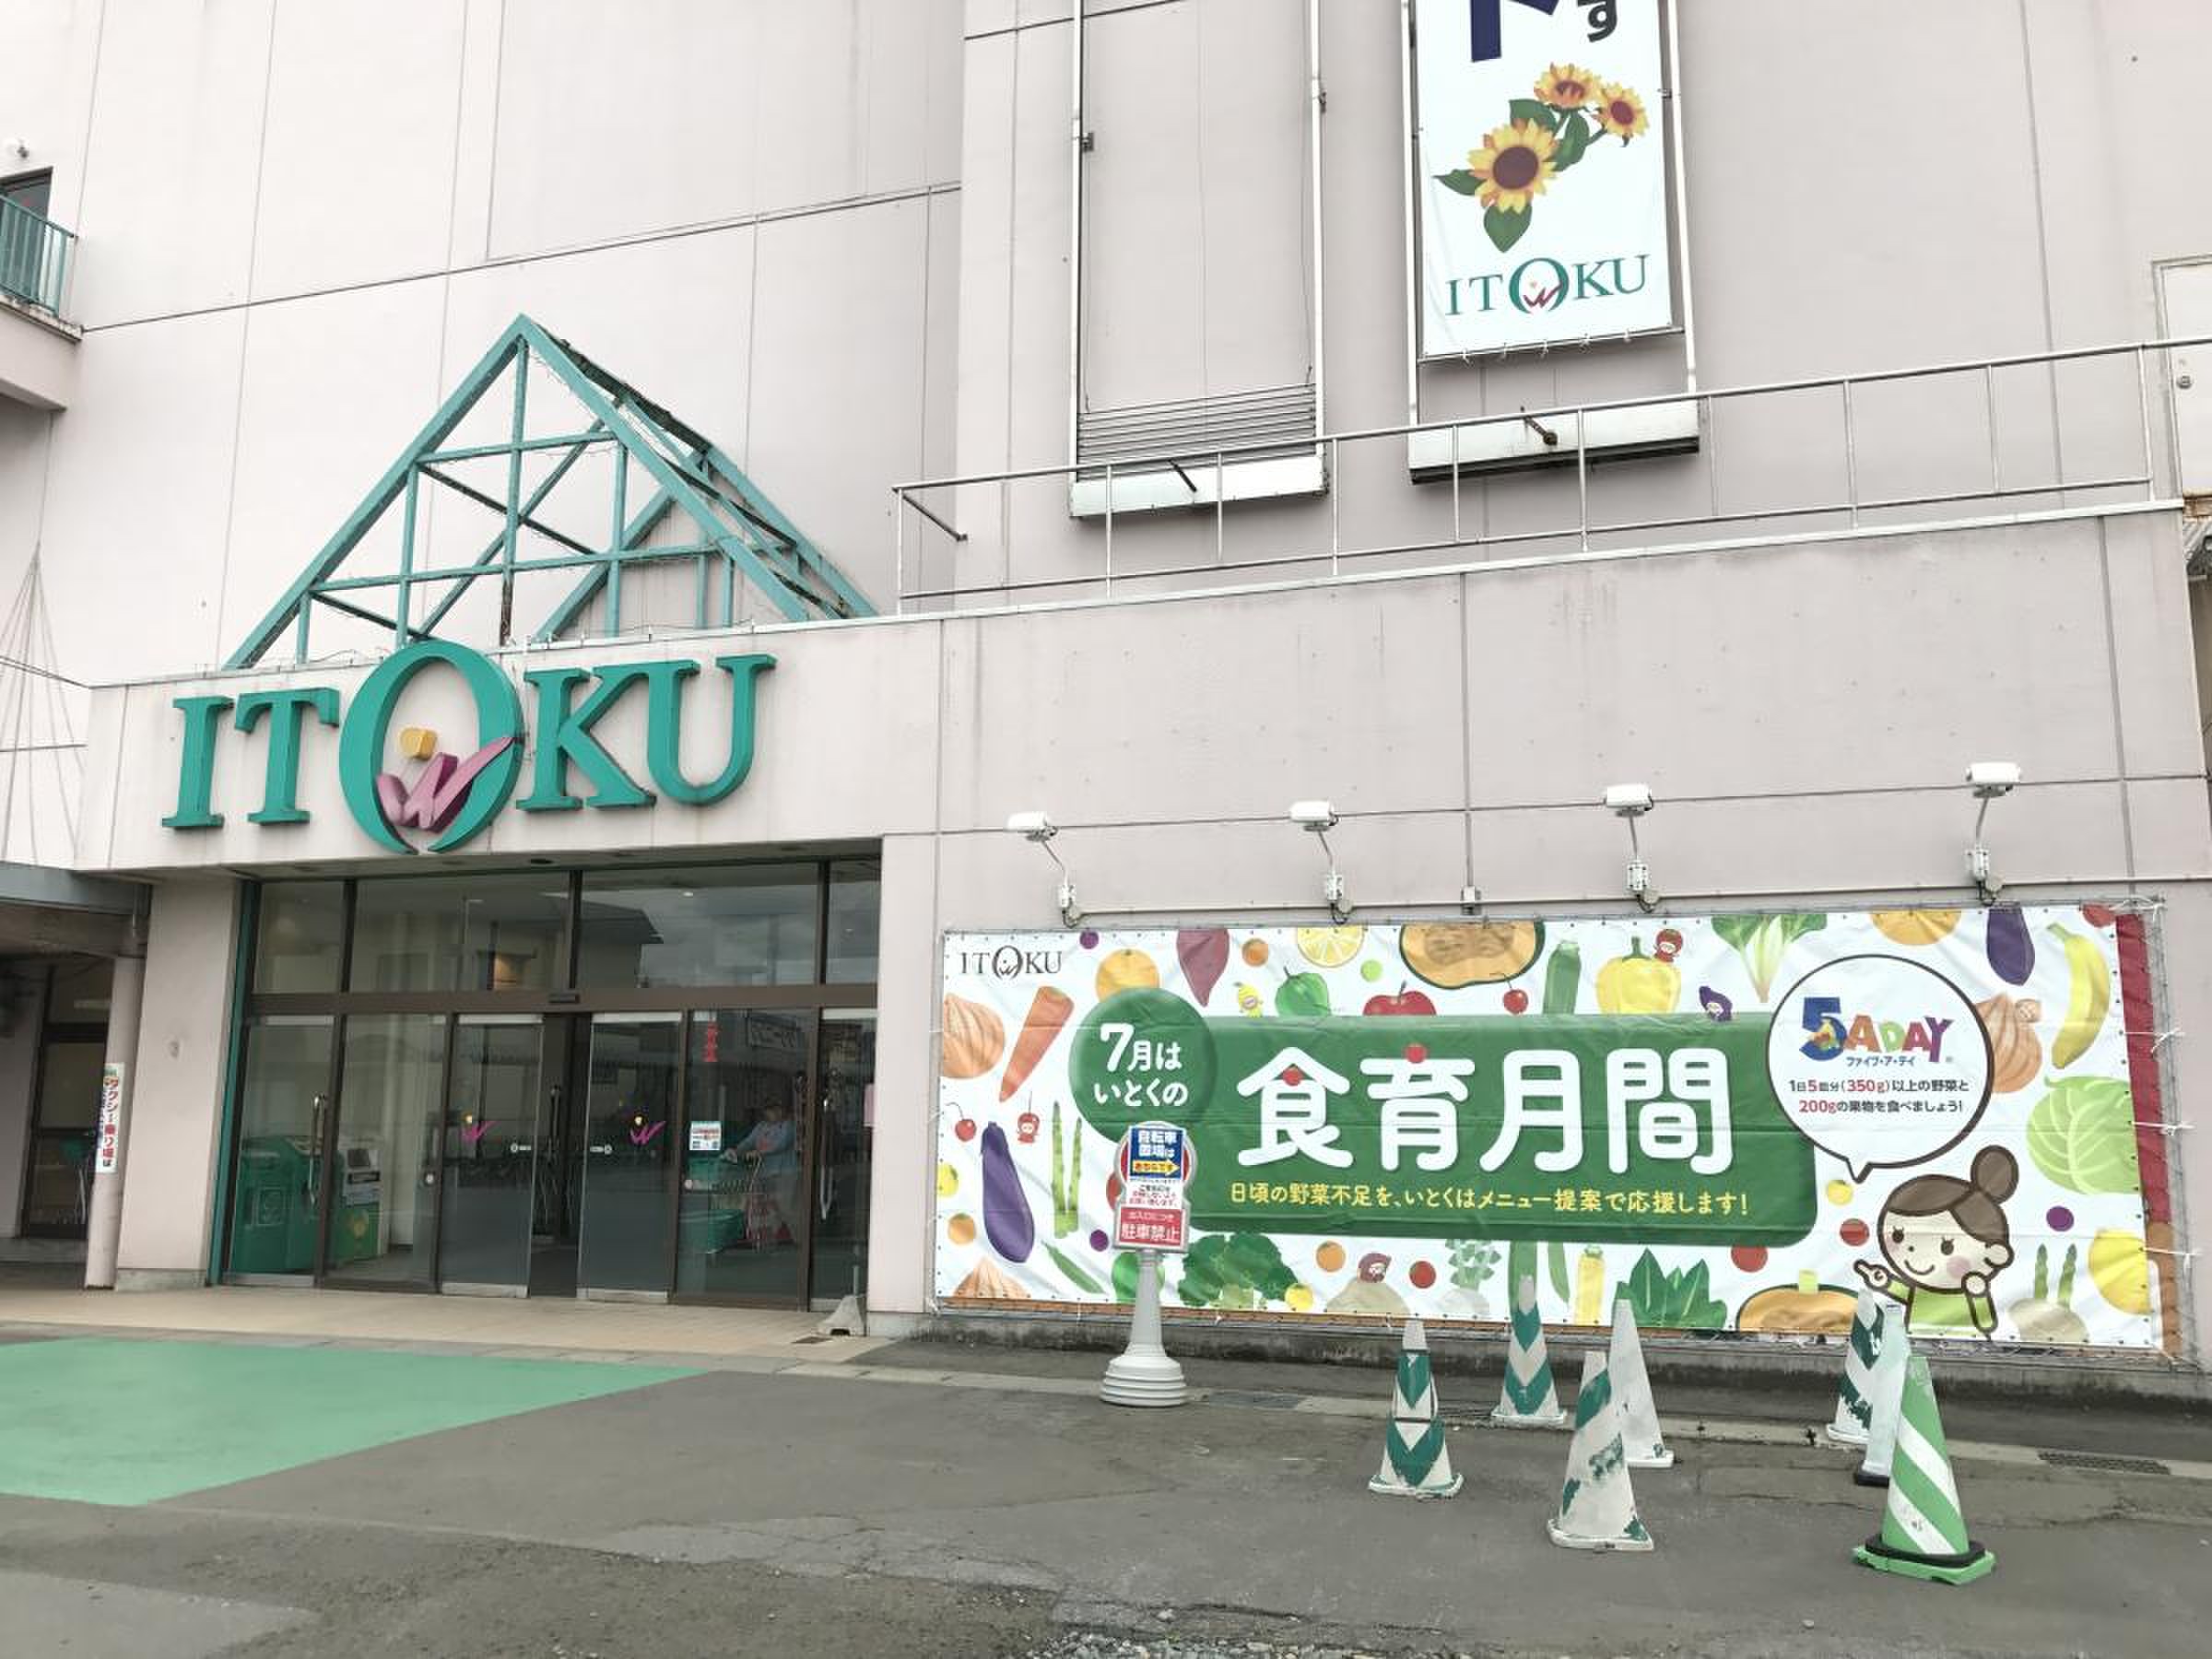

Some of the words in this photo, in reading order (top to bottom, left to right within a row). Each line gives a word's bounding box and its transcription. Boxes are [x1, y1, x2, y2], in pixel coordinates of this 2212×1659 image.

[1445, 253, 1651, 315] ITOKU
[162, 640, 777, 855] ITOKU
[960, 945, 1063, 979] ITOKU
[1100, 1022, 1182, 1072] 7月は
[1093, 1078, 1188, 1107] いとくの
[1236, 1045, 1733, 1175] 食育月間
